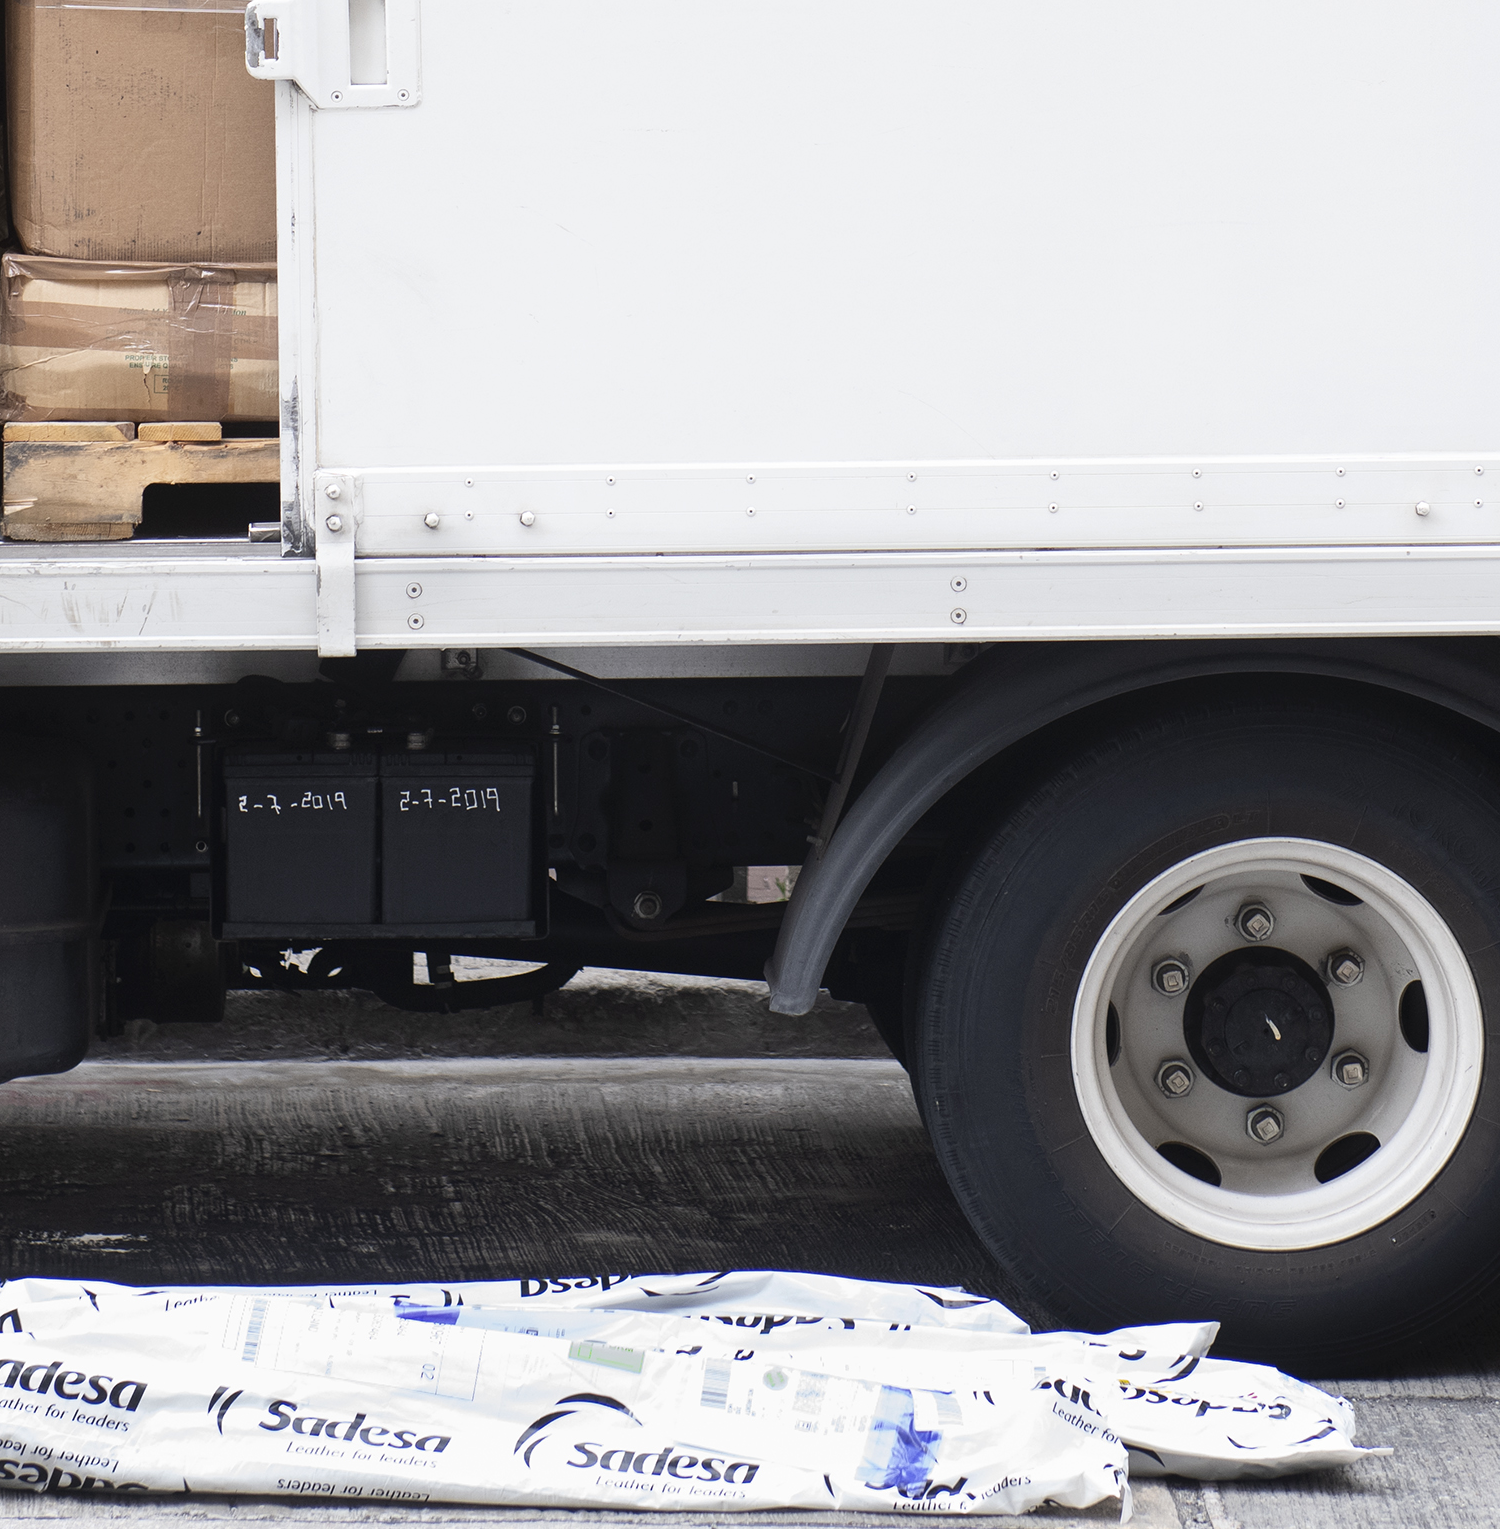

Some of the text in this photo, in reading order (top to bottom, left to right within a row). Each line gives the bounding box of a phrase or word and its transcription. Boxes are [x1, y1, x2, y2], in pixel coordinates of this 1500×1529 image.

[44, 1403, 70, 1421] for
[71, 1408, 131, 1433] leaders
[258, 1399, 453, 1454] Sadesa
[30, 1444, 54, 1461] for
[56, 1448, 119, 1473] Leather
[285, 1440, 438, 1469] Leather for leaders
[566, 1440, 760, 1485] Sadesa
[276, 1477, 337, 1494] leaders
[595, 1475, 656, 1492] Leather
[688, 1485, 747, 1499] leaders
